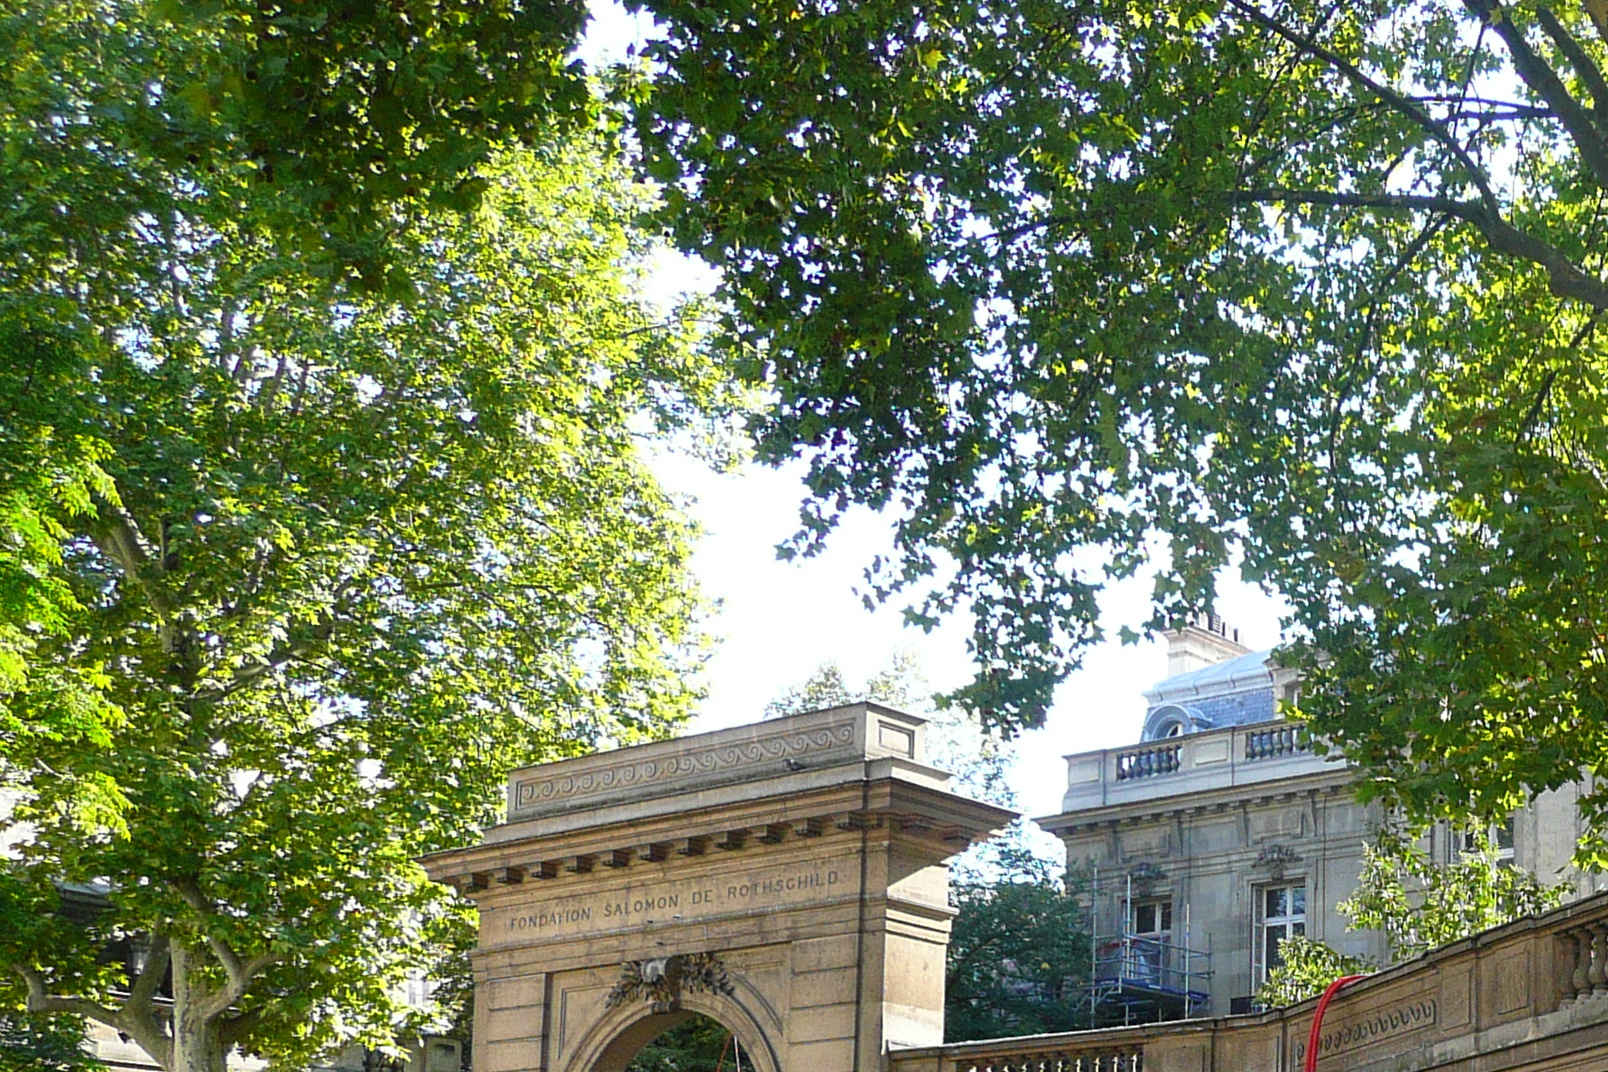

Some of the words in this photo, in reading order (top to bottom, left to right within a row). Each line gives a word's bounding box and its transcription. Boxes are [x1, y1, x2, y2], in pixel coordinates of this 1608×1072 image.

[510, 907, 592, 932] FONDATION
[603, 894, 680, 918] SALOMON
[692, 889, 714, 905] DE
[727, 870, 839, 900] ROTHSCHILD
